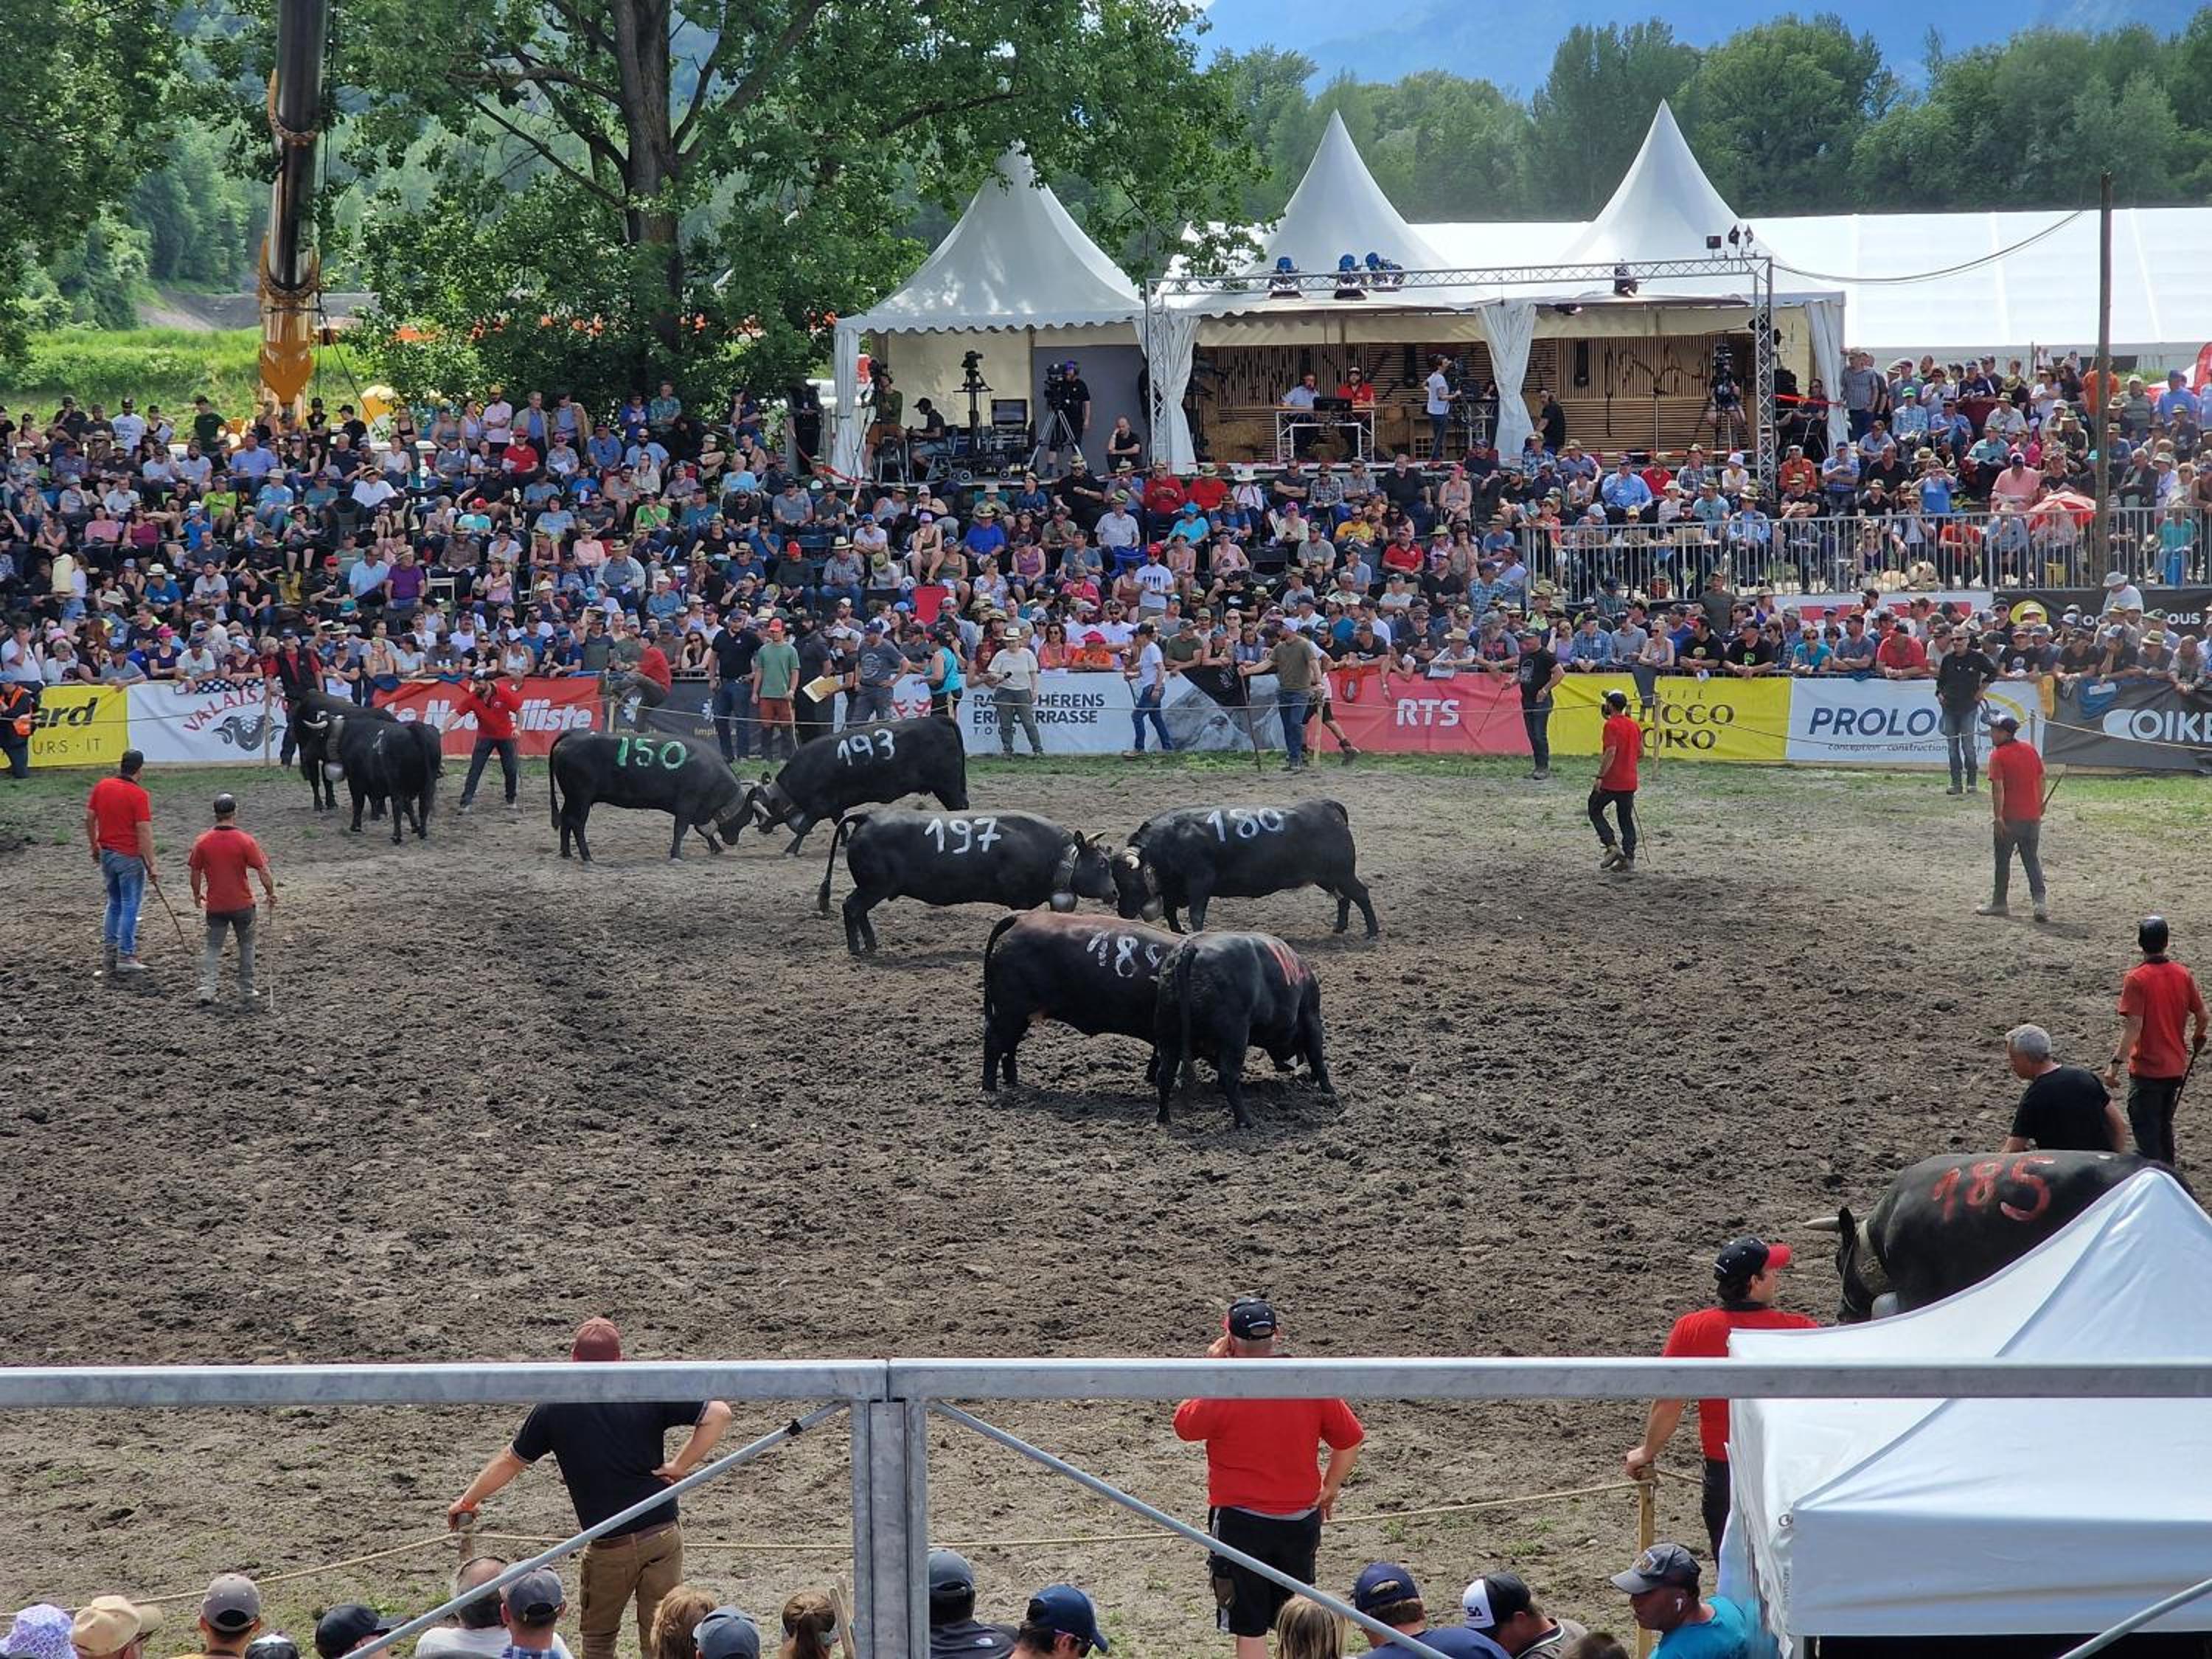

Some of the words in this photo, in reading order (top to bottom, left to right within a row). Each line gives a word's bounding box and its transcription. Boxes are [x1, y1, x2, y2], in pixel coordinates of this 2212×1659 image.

[35, 697, 99, 728] ard
[1397, 698, 1459, 726] RTS
[1809, 706, 1947, 737] PROLO
[616, 737, 687, 770] 150
[837, 728, 896, 767] 193
[924, 817, 1002, 854] 197
[1931, 1155, 2056, 1224] 185
